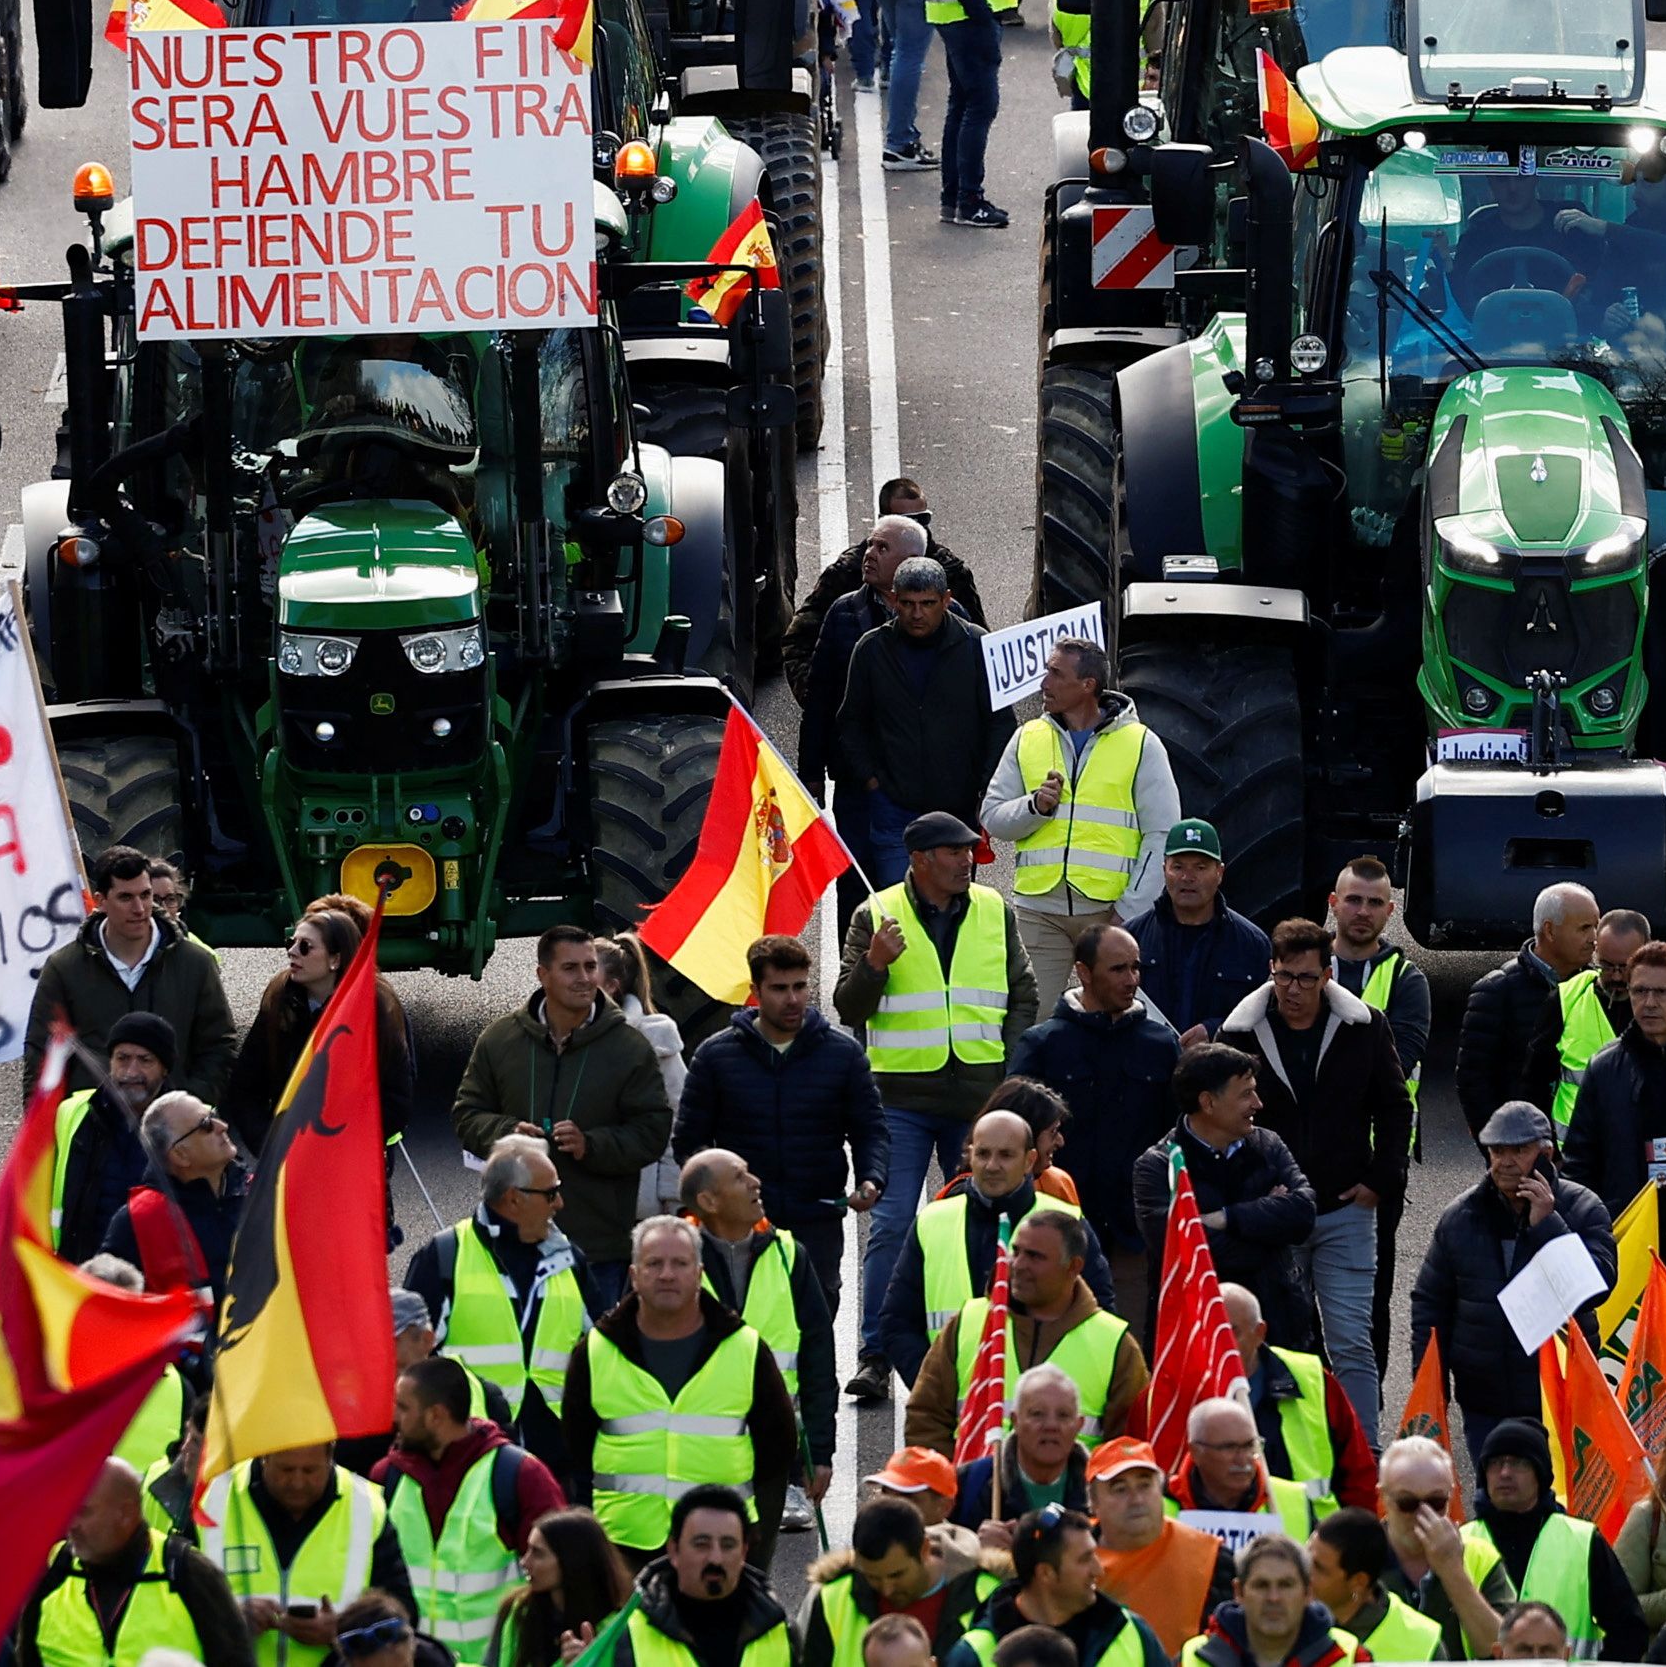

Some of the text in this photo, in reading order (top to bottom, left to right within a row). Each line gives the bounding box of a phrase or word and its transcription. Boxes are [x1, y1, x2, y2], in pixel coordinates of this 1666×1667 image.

[133, 18, 584, 90] NUESTRO FIN
[133, 83, 592, 149] SERA VUESTRA
[211, 146, 475, 208] HAMBRE
[137, 201, 575, 272] DEFIENDE TU
[137, 260, 598, 332] ALIMENTACION
